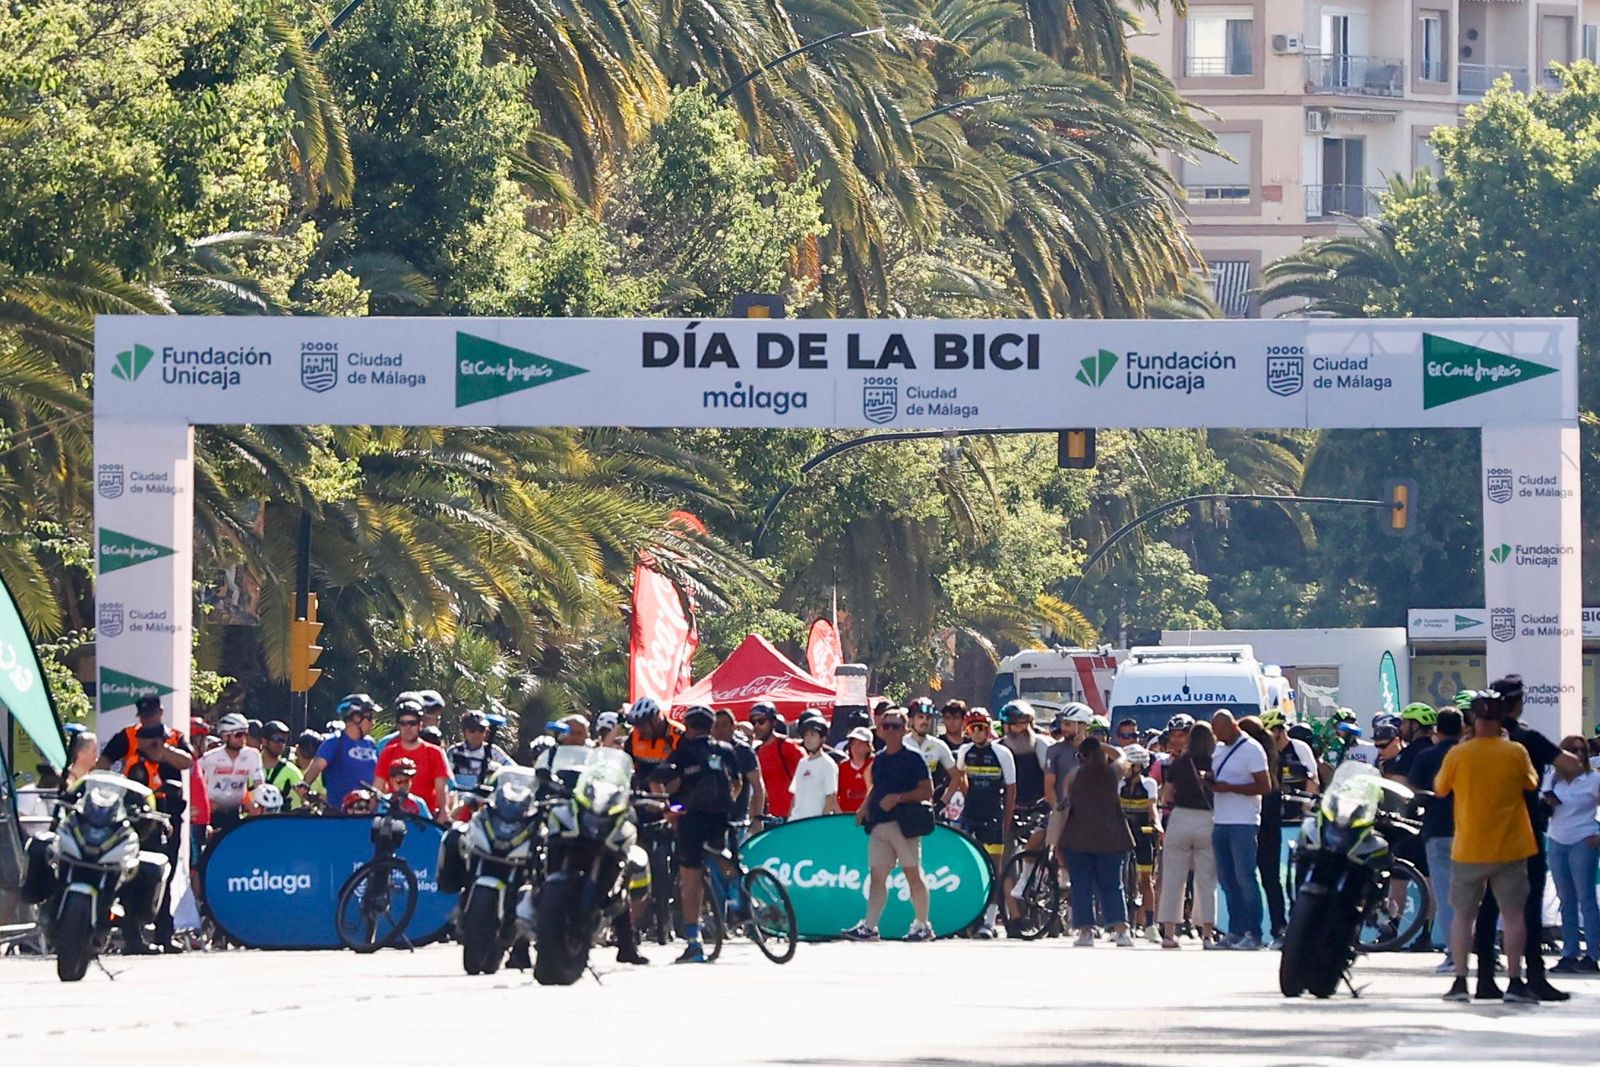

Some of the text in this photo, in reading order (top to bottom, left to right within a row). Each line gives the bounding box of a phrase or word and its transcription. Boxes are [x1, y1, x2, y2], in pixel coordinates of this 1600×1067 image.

[643, 321, 1039, 370] DÍA DE LA BICI
[163, 346, 271, 367] Fundación
[348, 353, 402, 367] Ciudad
[1127, 350, 1236, 371] Fundación
[461, 357, 553, 382] El Corte Inglés
[1313, 357, 1368, 371] Ciudad
[1427, 358, 1521, 382] El Corte Inglés
[163, 367, 240, 391] Unicaja
[348, 370, 425, 387] de Málaga
[1127, 371, 1205, 395] Unicaja
[1313, 374, 1392, 391] de Málaga
[906, 386, 957, 399] Ciudad
[906, 402, 979, 419] de Málaga
[130, 471, 167, 481] Ciudad
[1519, 475, 1557, 485] Ciudad
[130, 484, 143, 493] de
[1519, 487, 1573, 498] de Málaga
[1516, 555, 1558, 568] Unicaja
[129, 610, 166, 619] Ciudad
[1521, 614, 1558, 624] Ciudad
[129, 623, 143, 632] de
[1521, 627, 1534, 636] de
[1537, 627, 1575, 638] Málaga
[793, 859, 860, 890] Corte
